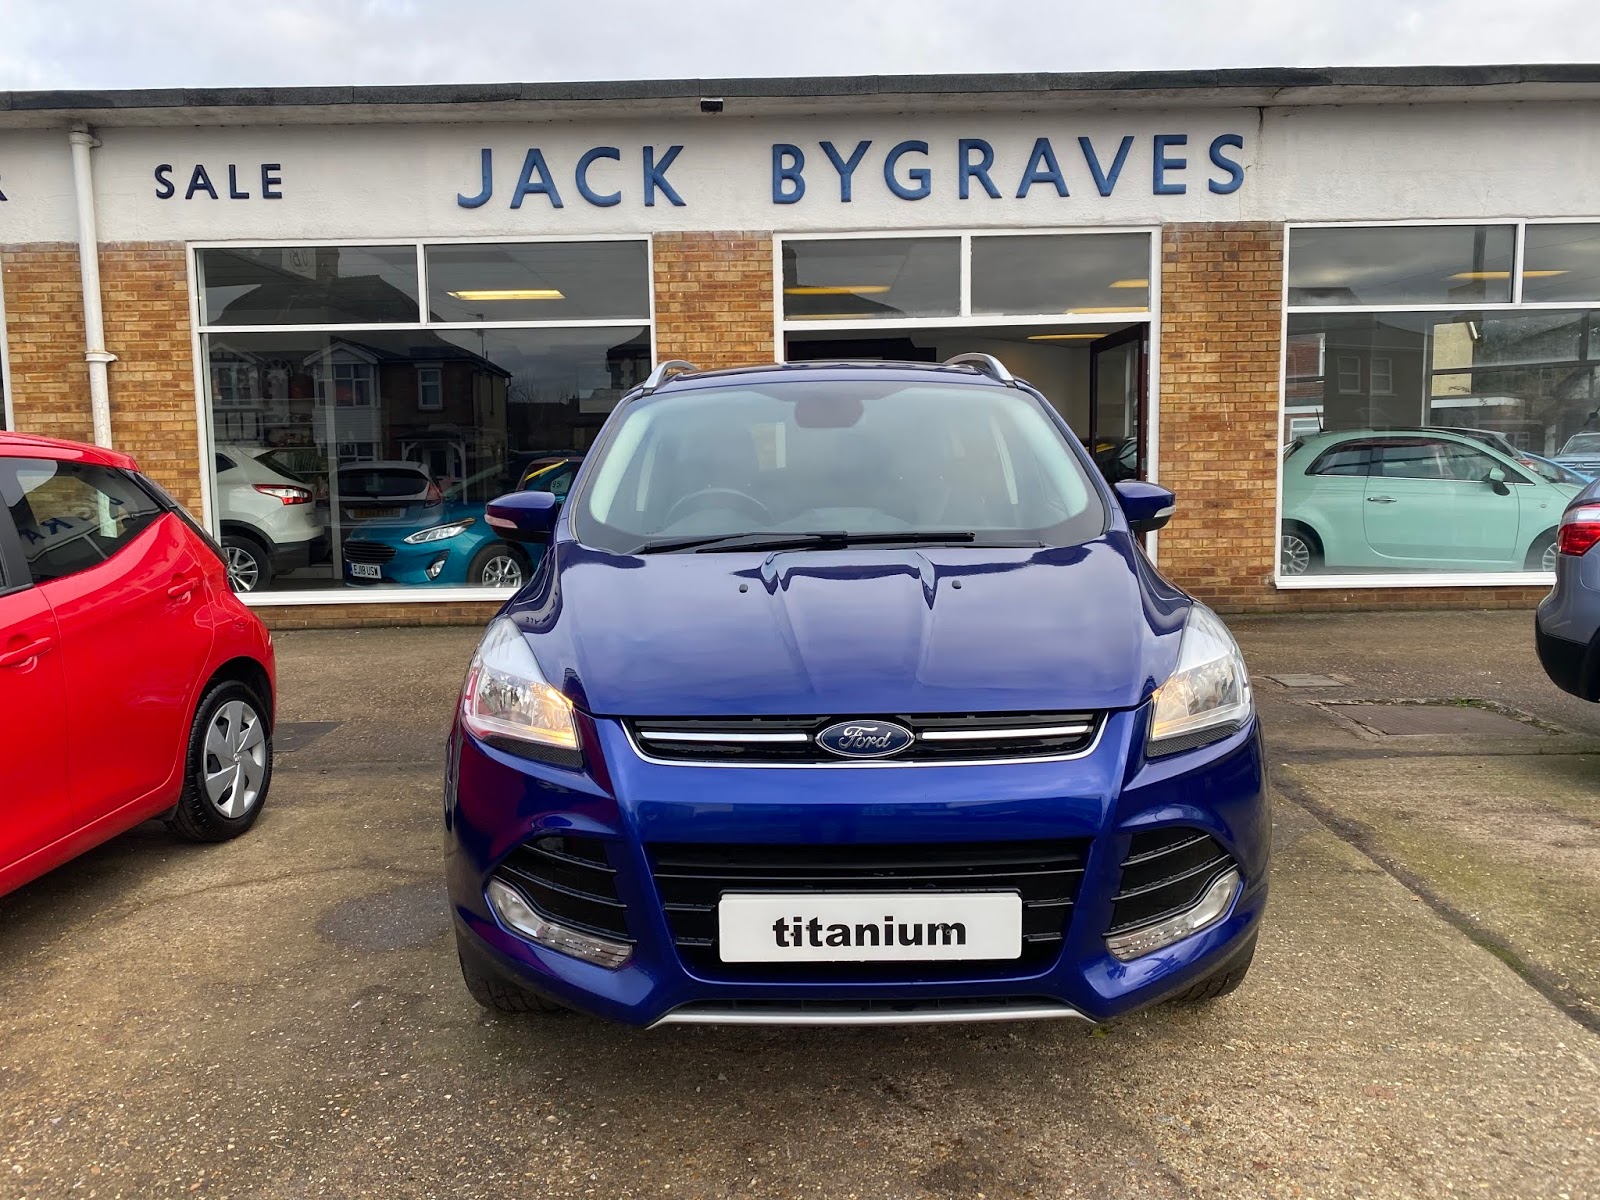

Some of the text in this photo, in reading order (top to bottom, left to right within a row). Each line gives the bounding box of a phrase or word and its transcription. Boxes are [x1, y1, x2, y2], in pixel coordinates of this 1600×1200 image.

[153, 164, 283, 200] SALE
[457, 133, 1245, 209] JACK BYGRAVES
[838, 726, 892, 749] Ford
[772, 916, 966, 947] titanium
